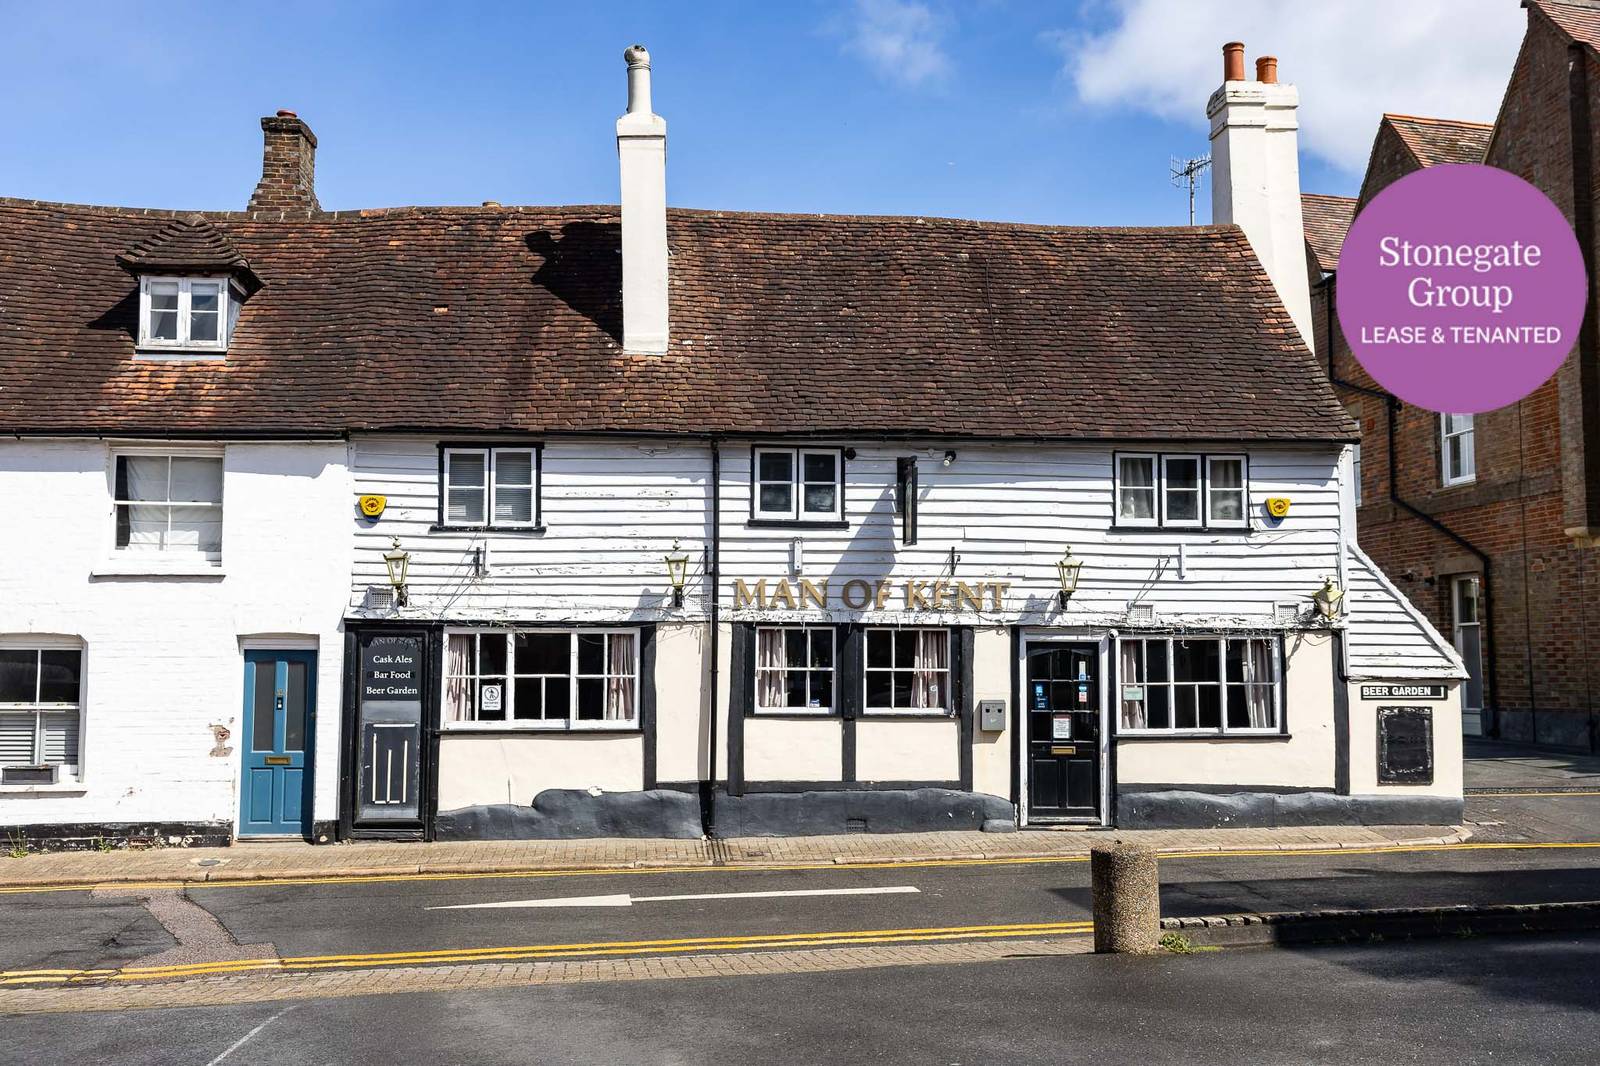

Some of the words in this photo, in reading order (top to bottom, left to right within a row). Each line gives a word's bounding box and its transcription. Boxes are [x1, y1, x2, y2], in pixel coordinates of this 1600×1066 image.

[734, 578, 829, 610] MAN
[842, 578, 892, 610] OF
[906, 580, 1010, 611] KENT
[372, 654, 394, 664] Cask
[394, 654, 413, 664] Ales
[374, 670, 389, 679] Bar
[390, 670, 411, 679] Food
[366, 686, 385, 695] Beer
[387, 686, 418, 695] Garden
[1362, 687, 1390, 696] BEER
[1391, 687, 1432, 696] GARDEN
